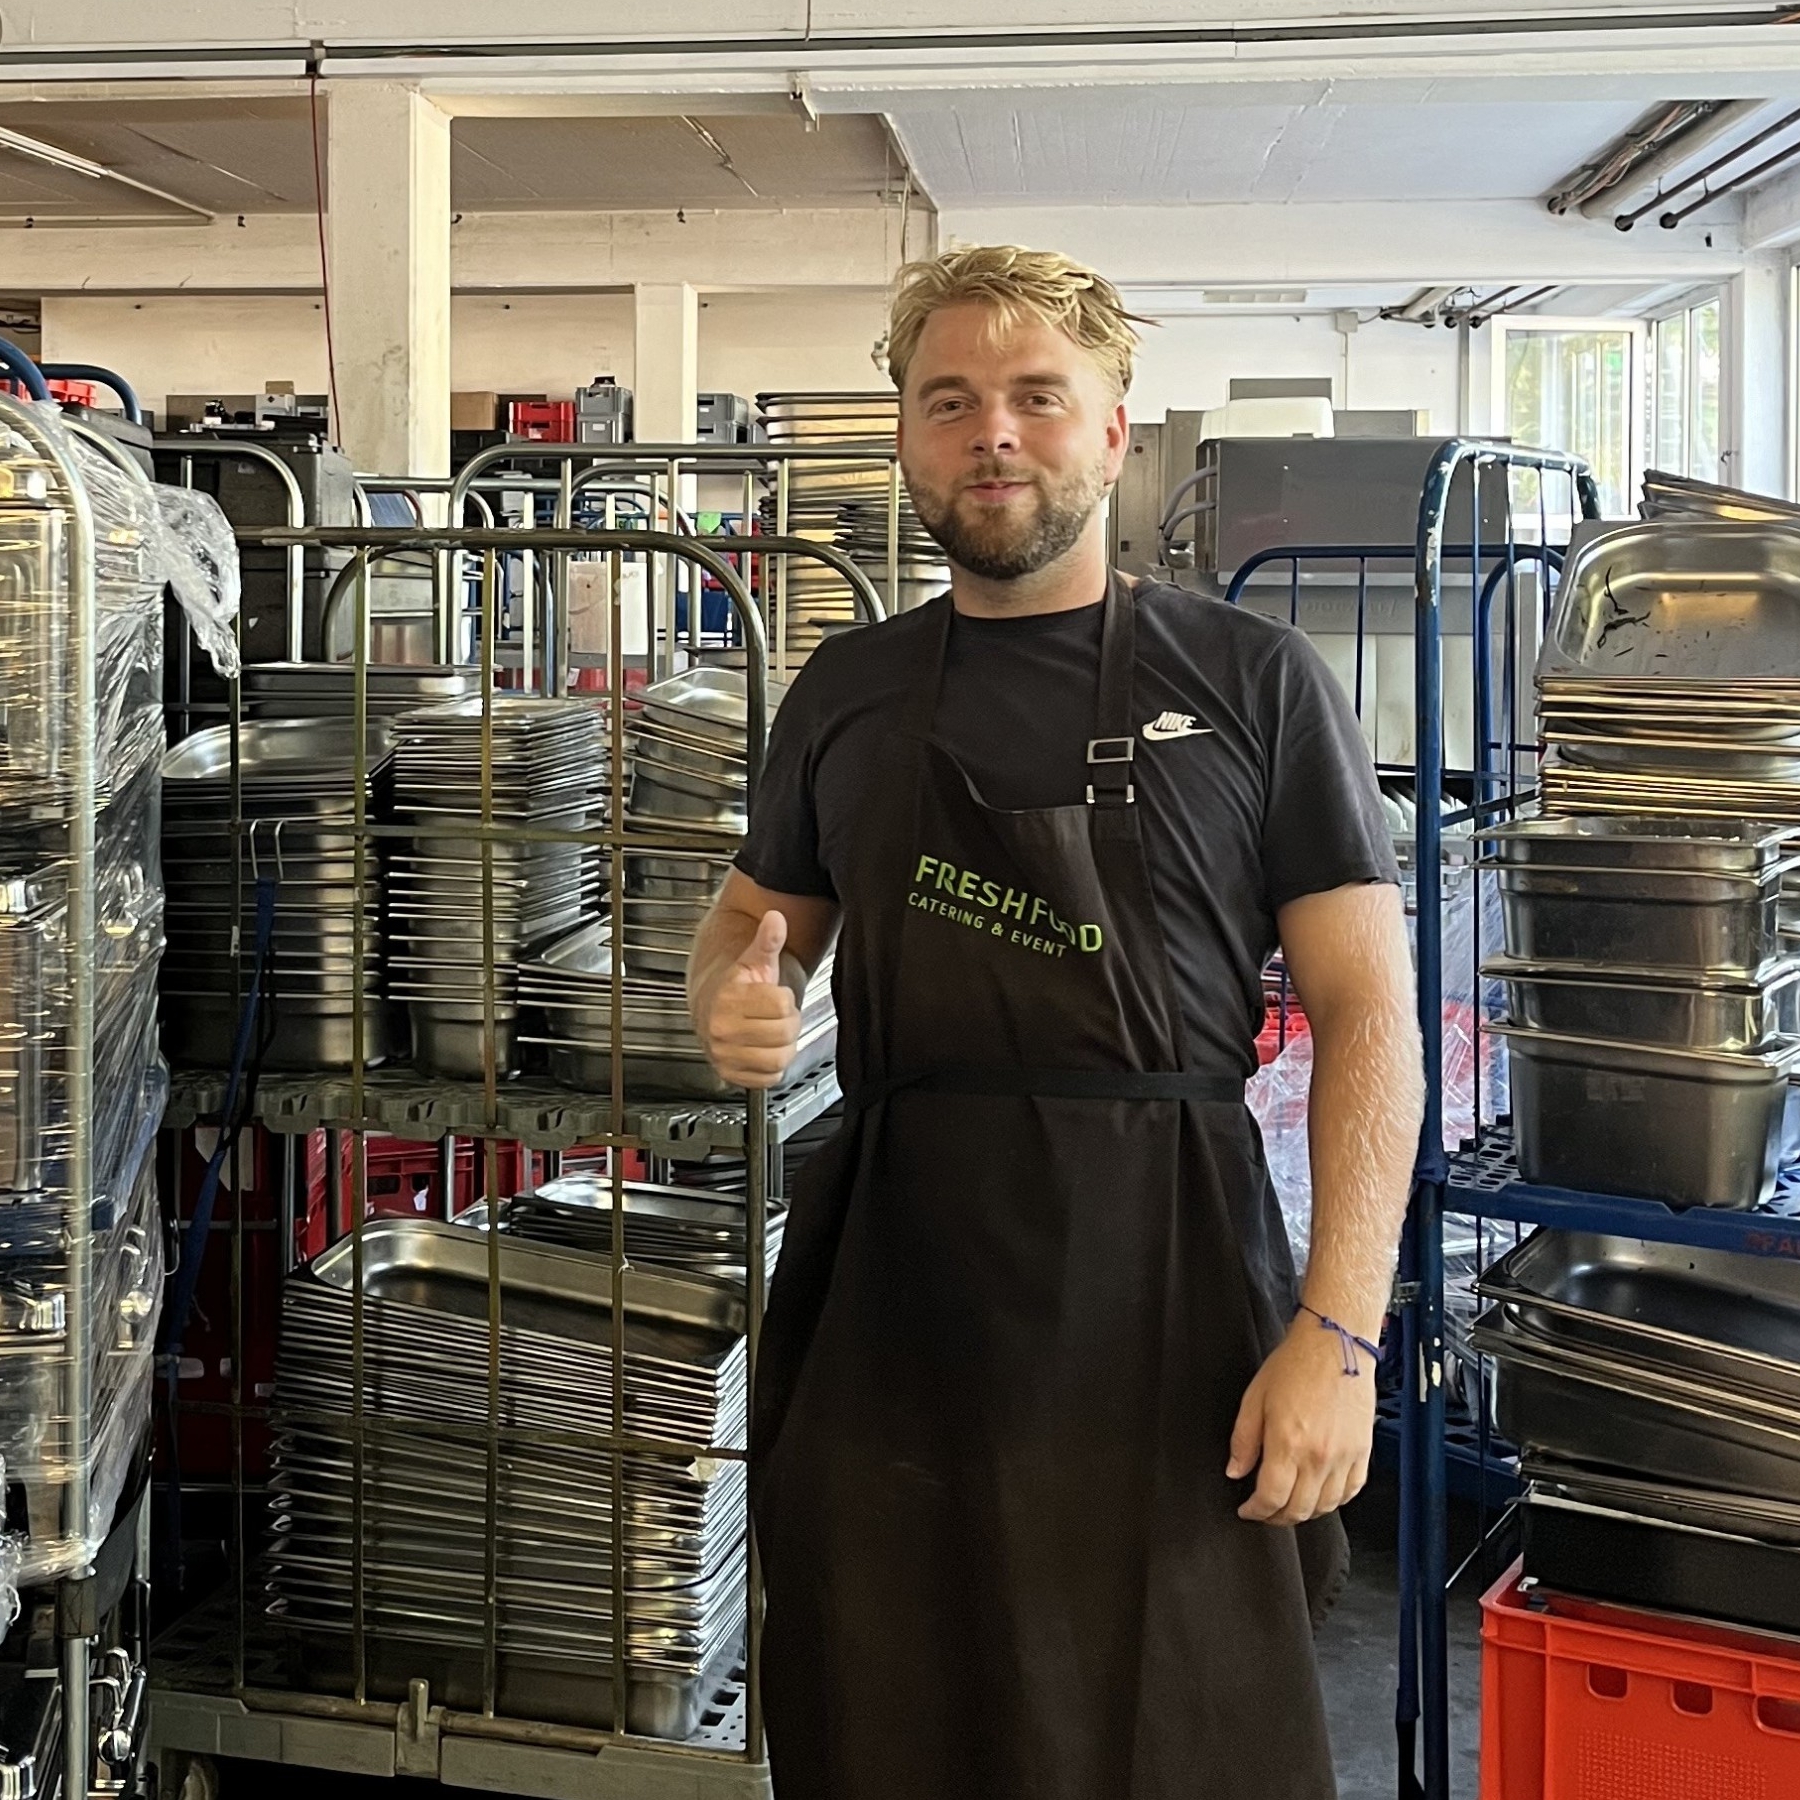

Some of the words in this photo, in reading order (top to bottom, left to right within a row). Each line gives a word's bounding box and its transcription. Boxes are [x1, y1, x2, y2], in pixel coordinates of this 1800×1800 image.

[1154, 711, 1197, 731] NIKE
[908, 892, 985, 929] CATERING
[991, 922, 1004, 937] &
[1010, 930, 1068, 958] EVENT
